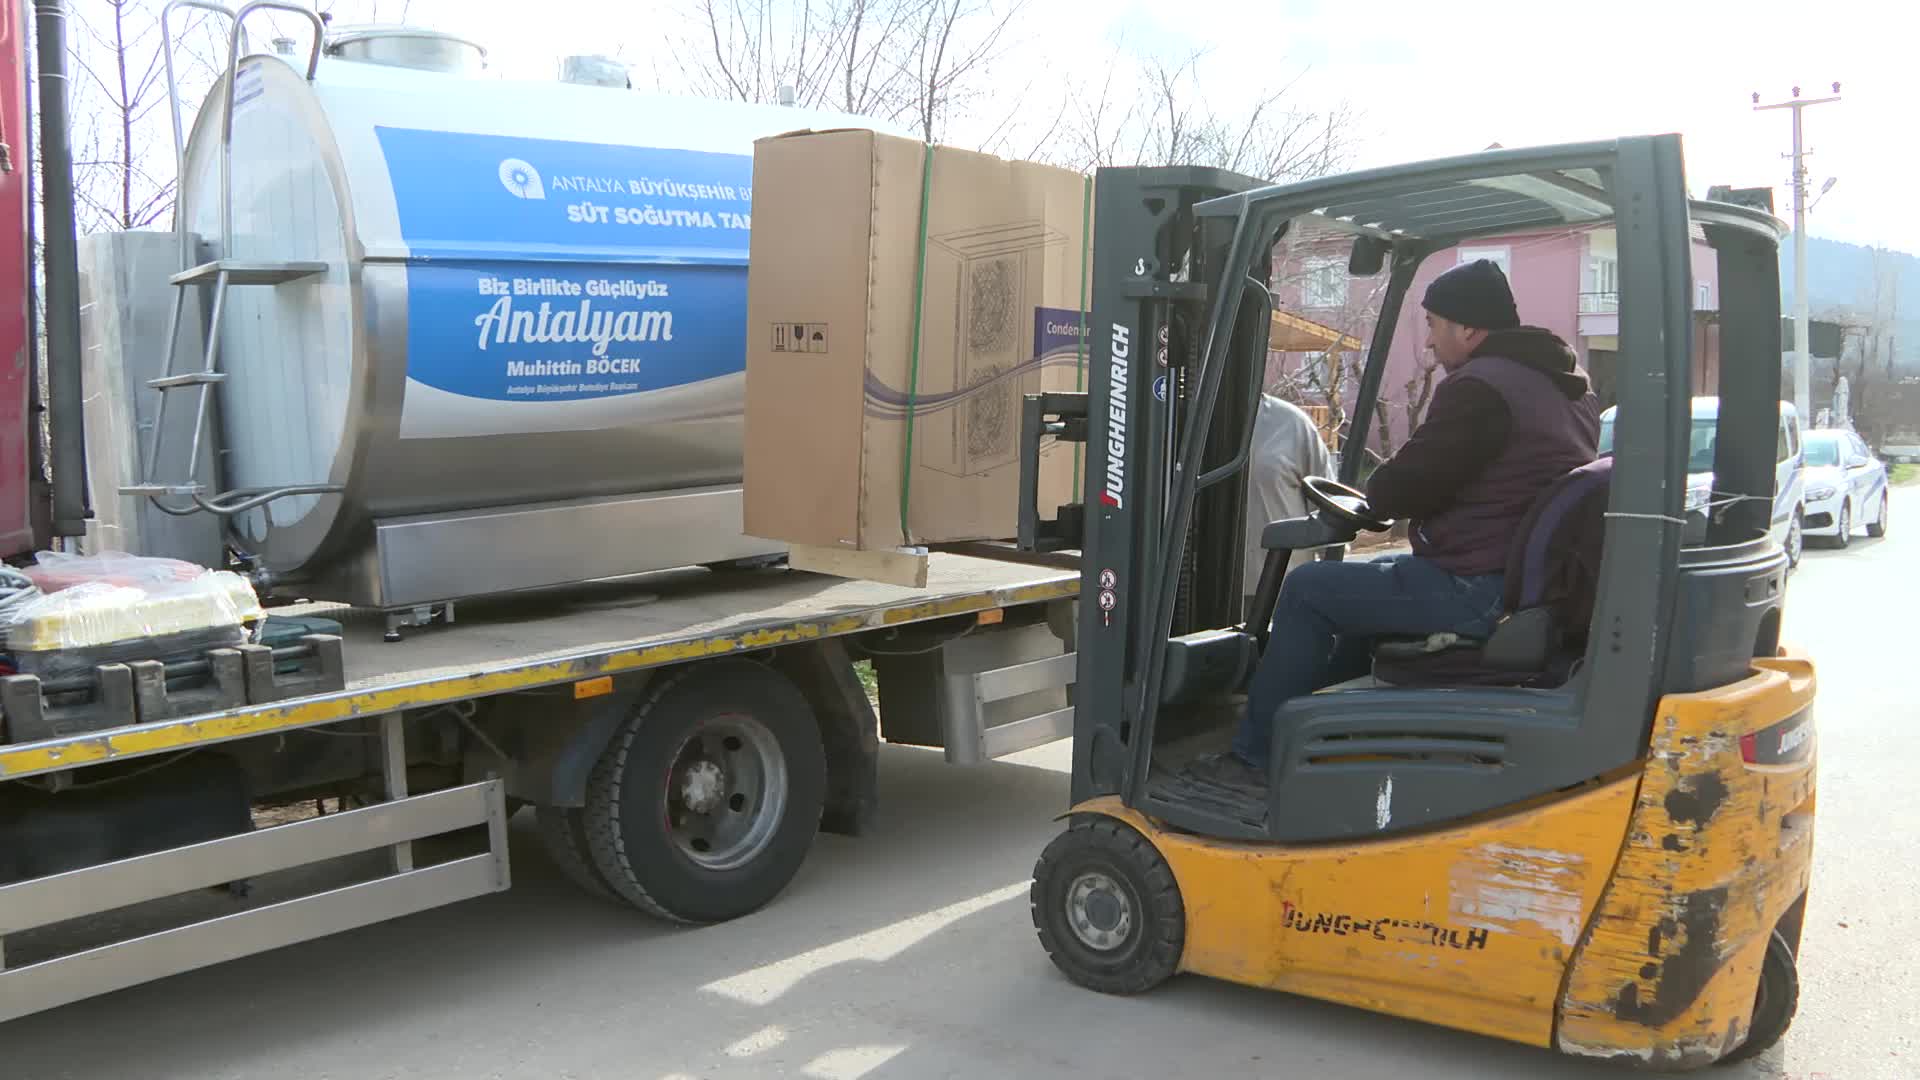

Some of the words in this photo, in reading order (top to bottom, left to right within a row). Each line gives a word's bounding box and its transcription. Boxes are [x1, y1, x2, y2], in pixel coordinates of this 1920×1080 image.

[551, 175, 625, 193] ANTALYA
[628, 177, 737, 201] BÜYÜKŞEHİR
[567, 201, 609, 224] SÜT
[614, 203, 717, 229] SOĞUTMA
[478, 278, 510, 296] Biz
[513, 278, 582, 296] Birlikte
[585, 279, 669, 300] Güçlüyüz
[474, 295, 674, 356] Antalyam
[506, 359, 582, 377] Muhittin
[586, 355, 641, 375] BÖCEK
[1101, 322, 1130, 509] JUNGHEINRICH
